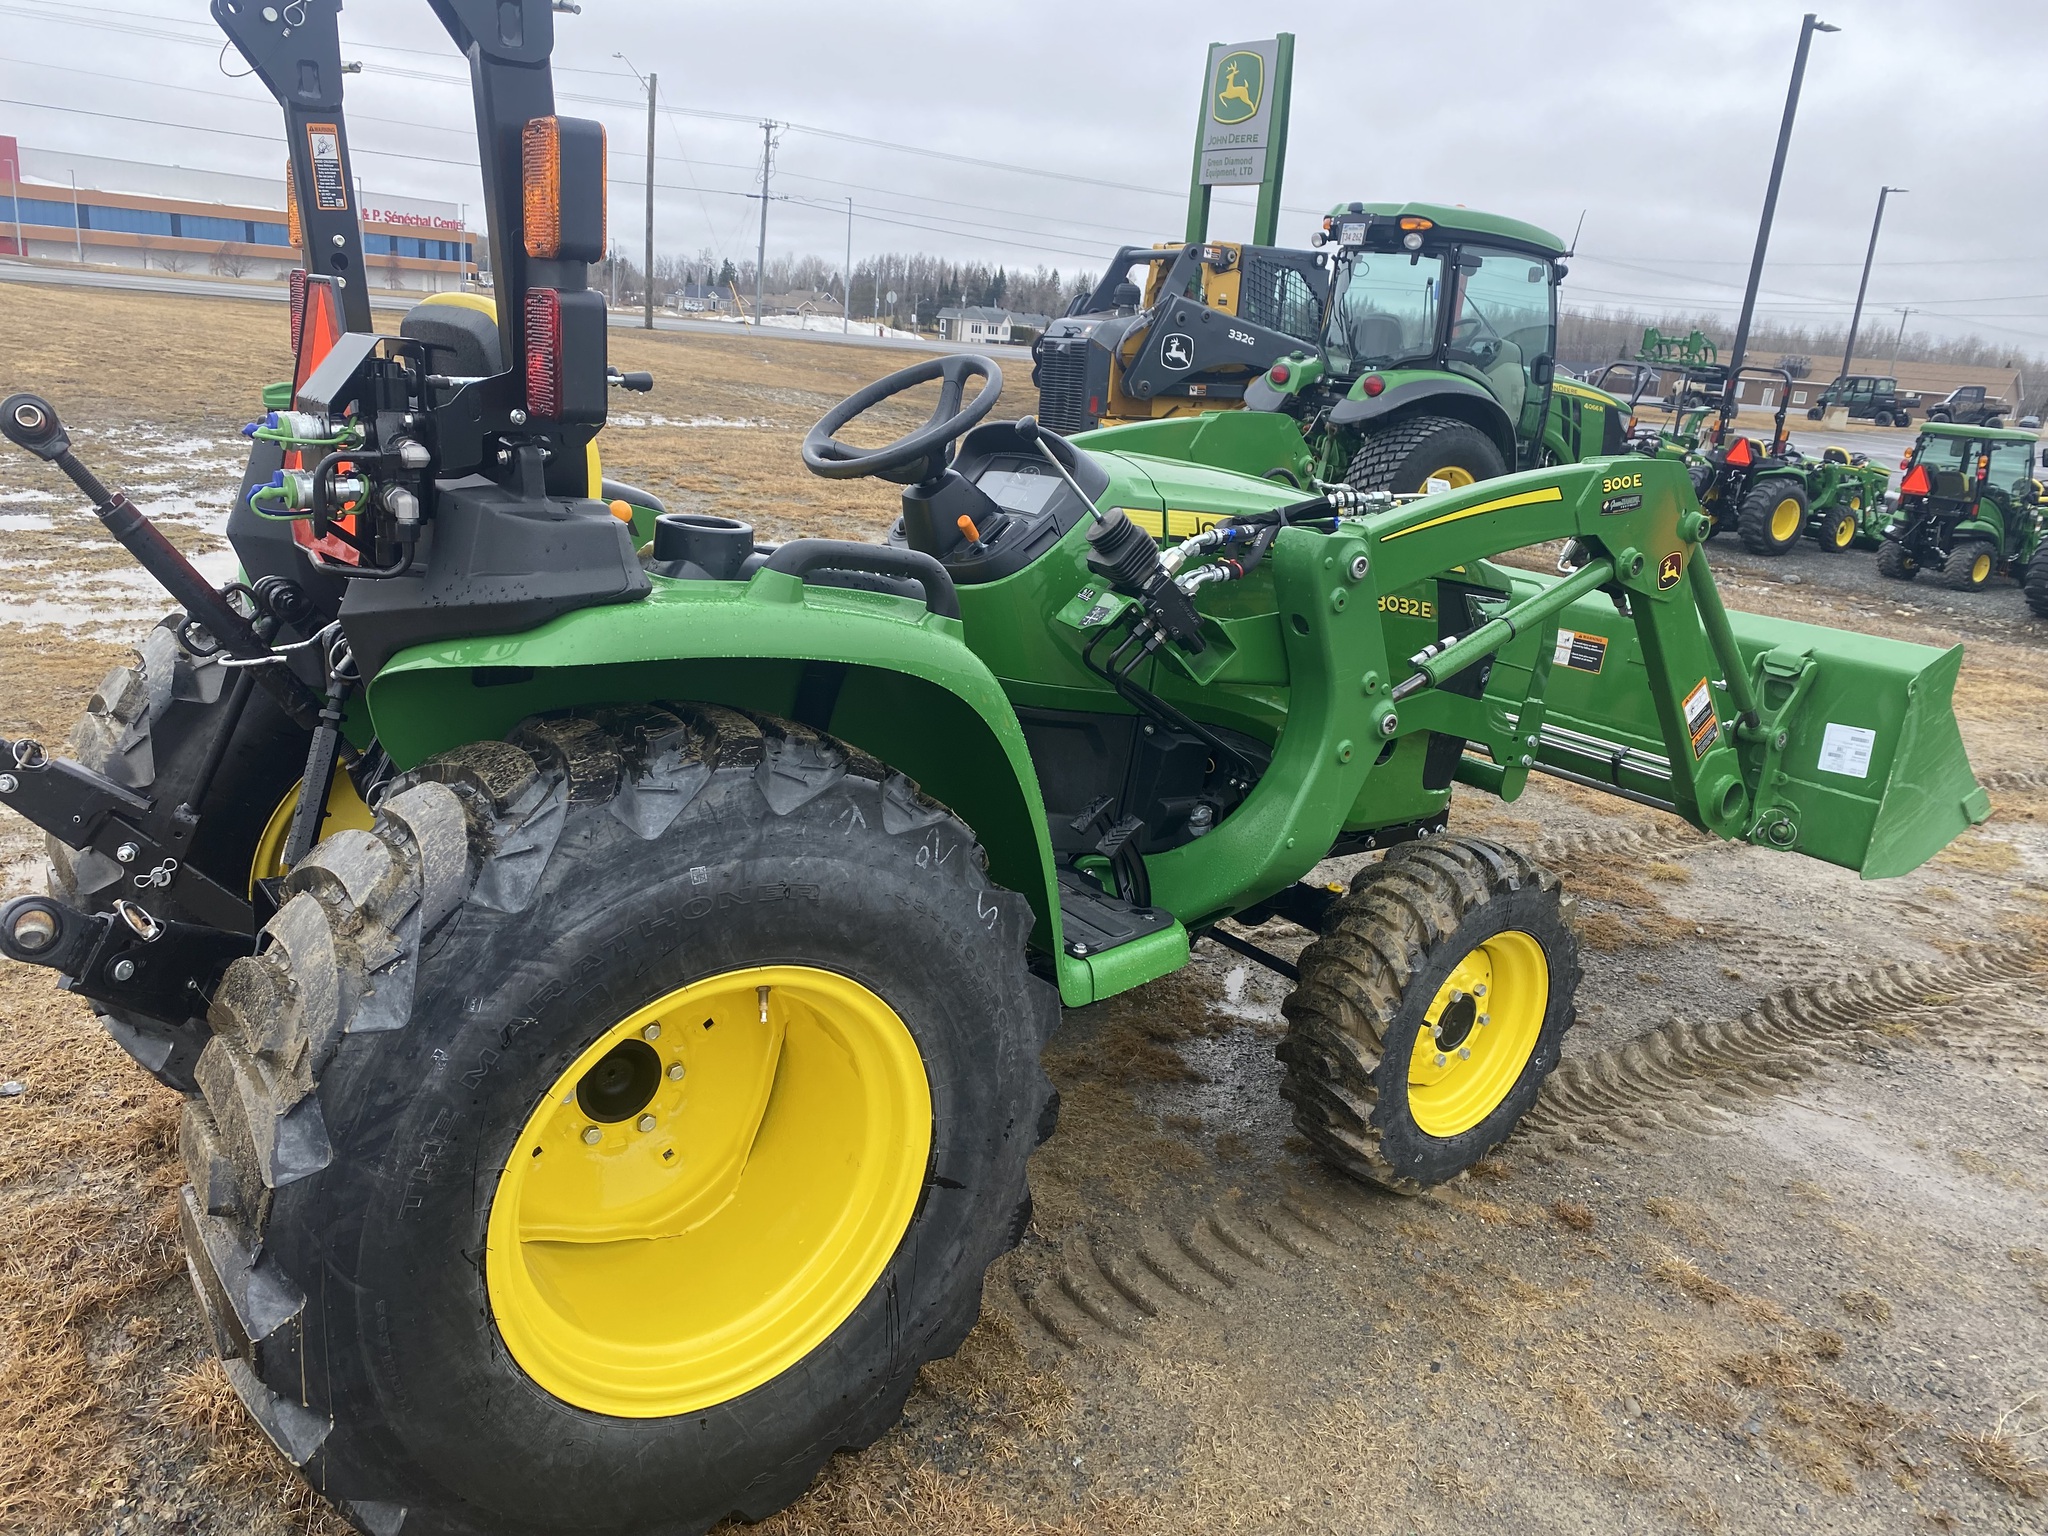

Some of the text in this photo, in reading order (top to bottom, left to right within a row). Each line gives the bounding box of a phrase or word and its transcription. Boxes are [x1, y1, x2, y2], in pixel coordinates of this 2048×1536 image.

[1228, 133, 1259, 144] DEERE
[1207, 156, 1253, 167] Green Diamond
[1239, 166, 1253, 176] LTD
[384, 210, 431, 227] Sénéchal
[434, 216, 466, 231] Center
[1228, 328, 1255, 346] 332G
